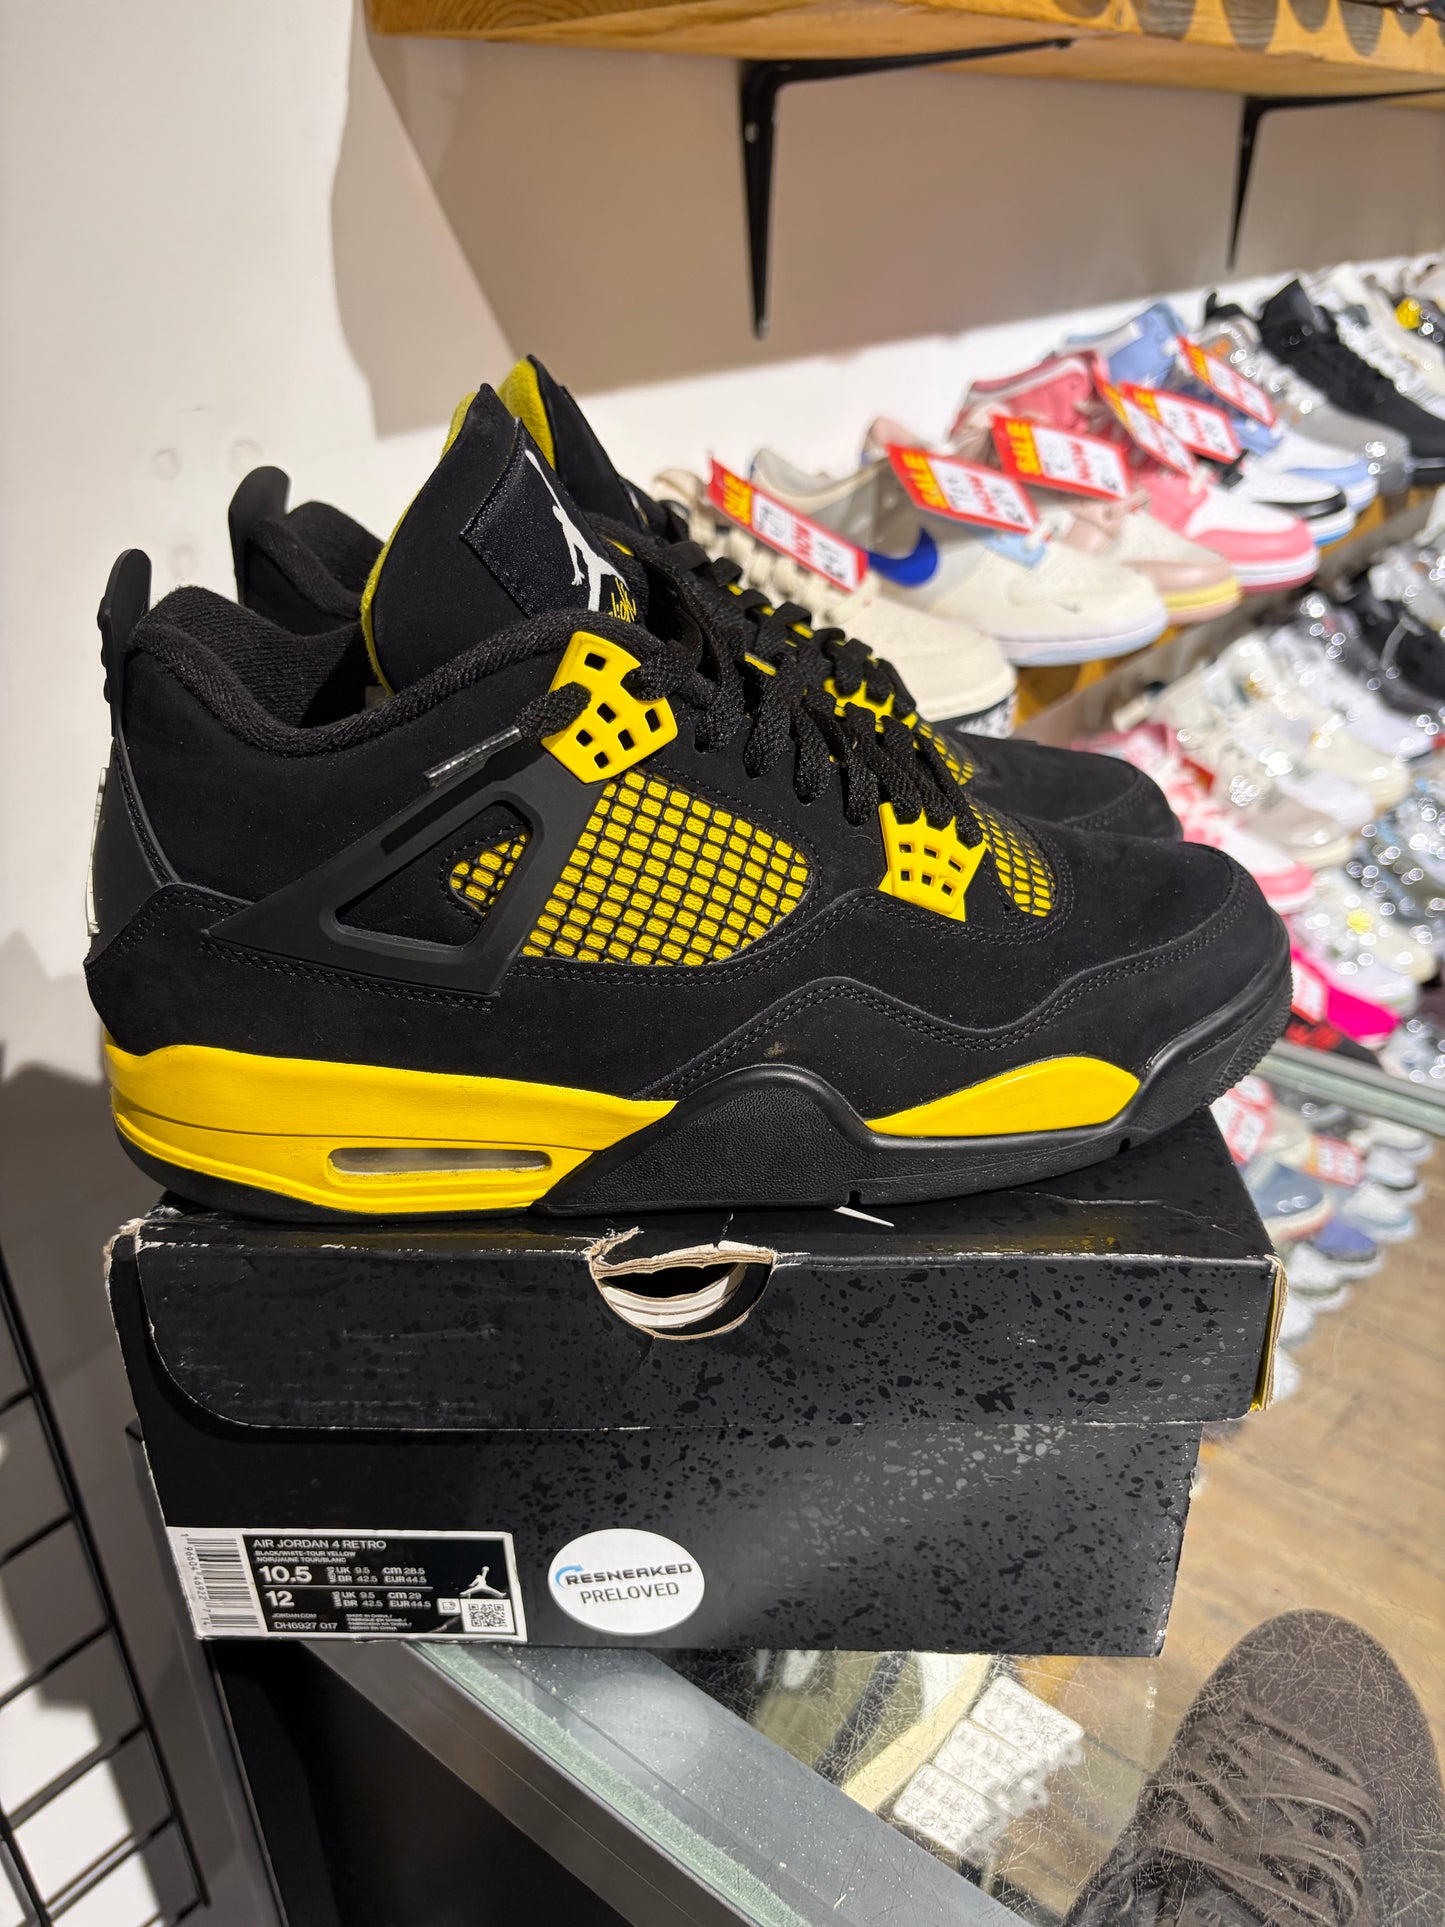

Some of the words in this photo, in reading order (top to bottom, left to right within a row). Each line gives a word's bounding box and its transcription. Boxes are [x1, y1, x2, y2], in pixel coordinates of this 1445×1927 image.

[902, 451, 951, 511] SALE
[253, 1539, 275, 1549] AIR
[276, 1539, 330, 1550] JORDAN
[331, 1540, 341, 1550] 4
[342, 1540, 387, 1551] RETRO
[260, 1565, 313, 1584] 10.5
[336, 1567, 351, 1575] UK
[354, 1567, 371, 1575] 9.5
[381, 1567, 403, 1575] cm
[403, 1567, 426, 1576] 28.5
[565, 1562, 693, 1586] RESNEAKED
[338, 1575, 353, 1583] BR
[357, 1575, 378, 1584] 42.5
[265, 1590, 295, 1608] 12
[341, 1591, 357, 1600] UK
[359, 1591, 376, 1600] 9.5
[386, 1592, 408, 1600] cm
[579, 1581, 680, 1605] PRELOVED
[343, 1600, 358, 1608] BR
[361, 1600, 384, 1609] 42.5
[273, 1621, 317, 1630] DH6927
[319, 1621, 338, 1630] 017
